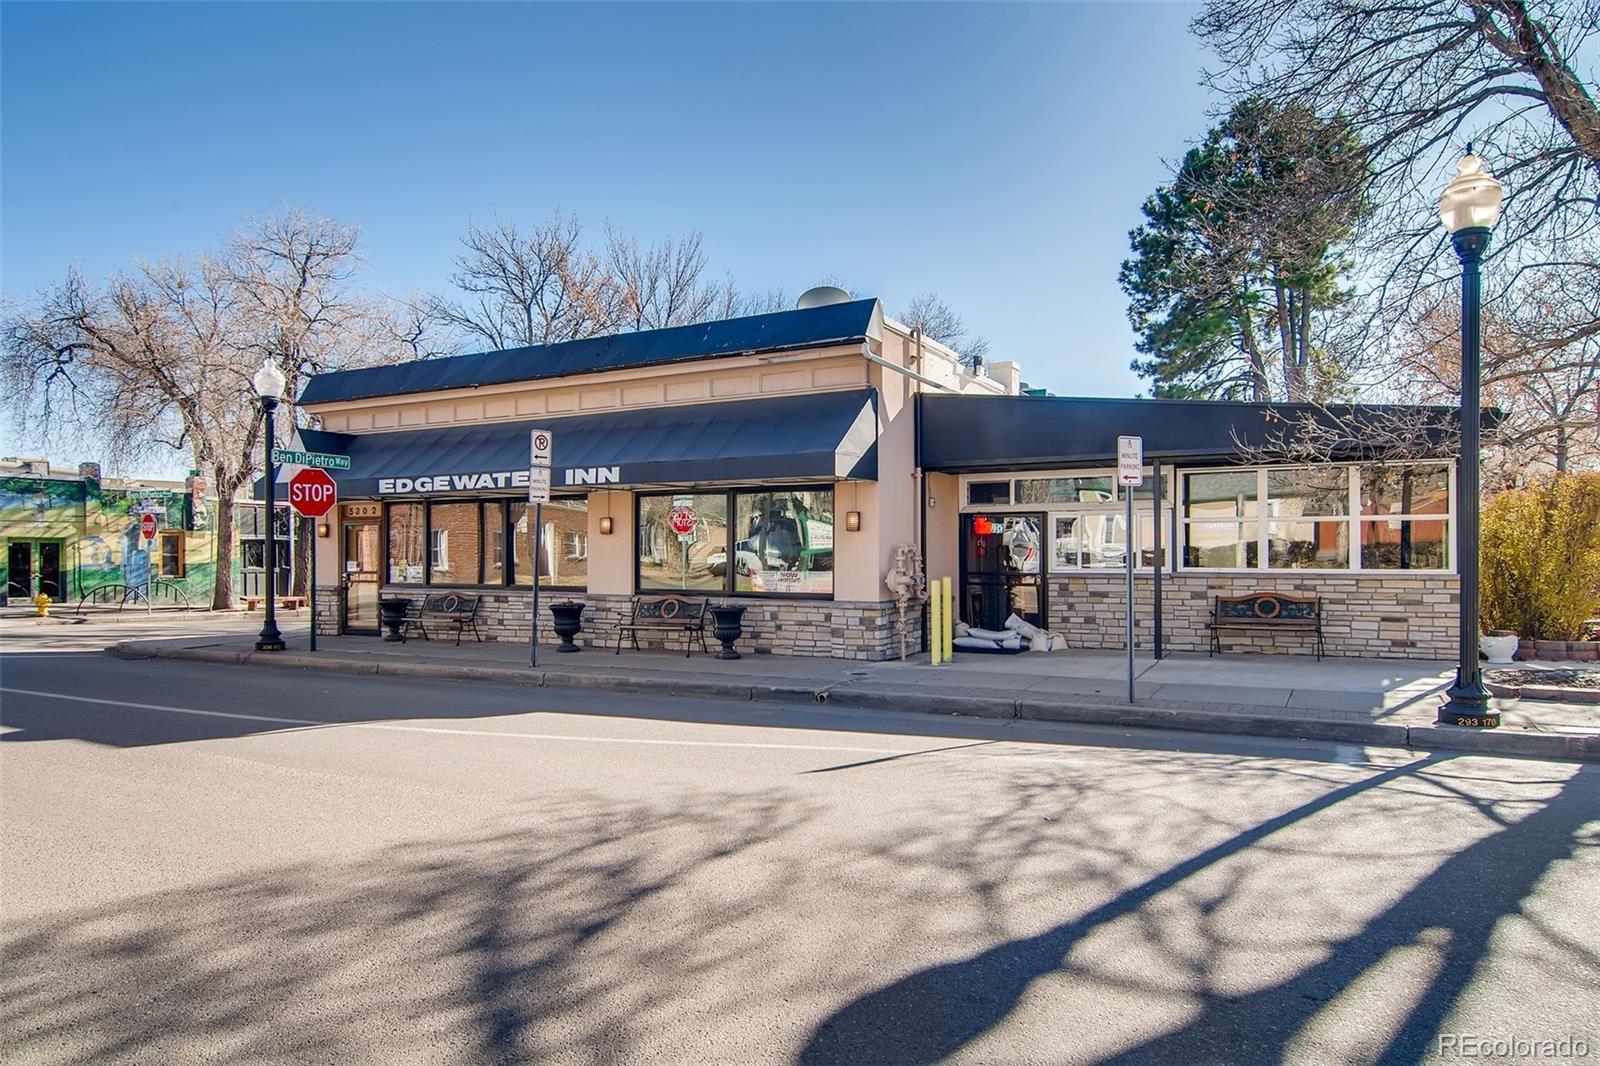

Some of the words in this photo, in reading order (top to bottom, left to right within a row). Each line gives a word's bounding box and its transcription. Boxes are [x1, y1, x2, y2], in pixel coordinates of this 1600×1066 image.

[272, 451, 293, 463] Ben
[295, 454, 335, 467] DiPietro
[335, 458, 350, 468] Way
[1121, 452, 1138, 460] MINUTE
[378, 470, 531, 494] EDGEWATE
[565, 466, 620, 485] INN
[292, 483, 333, 502] STOP
[349, 506, 377, 516] 5302
[142, 521, 154, 532] STOP
[1457, 717, 1479, 727] 293
[1482, 718, 1497, 727] 170
